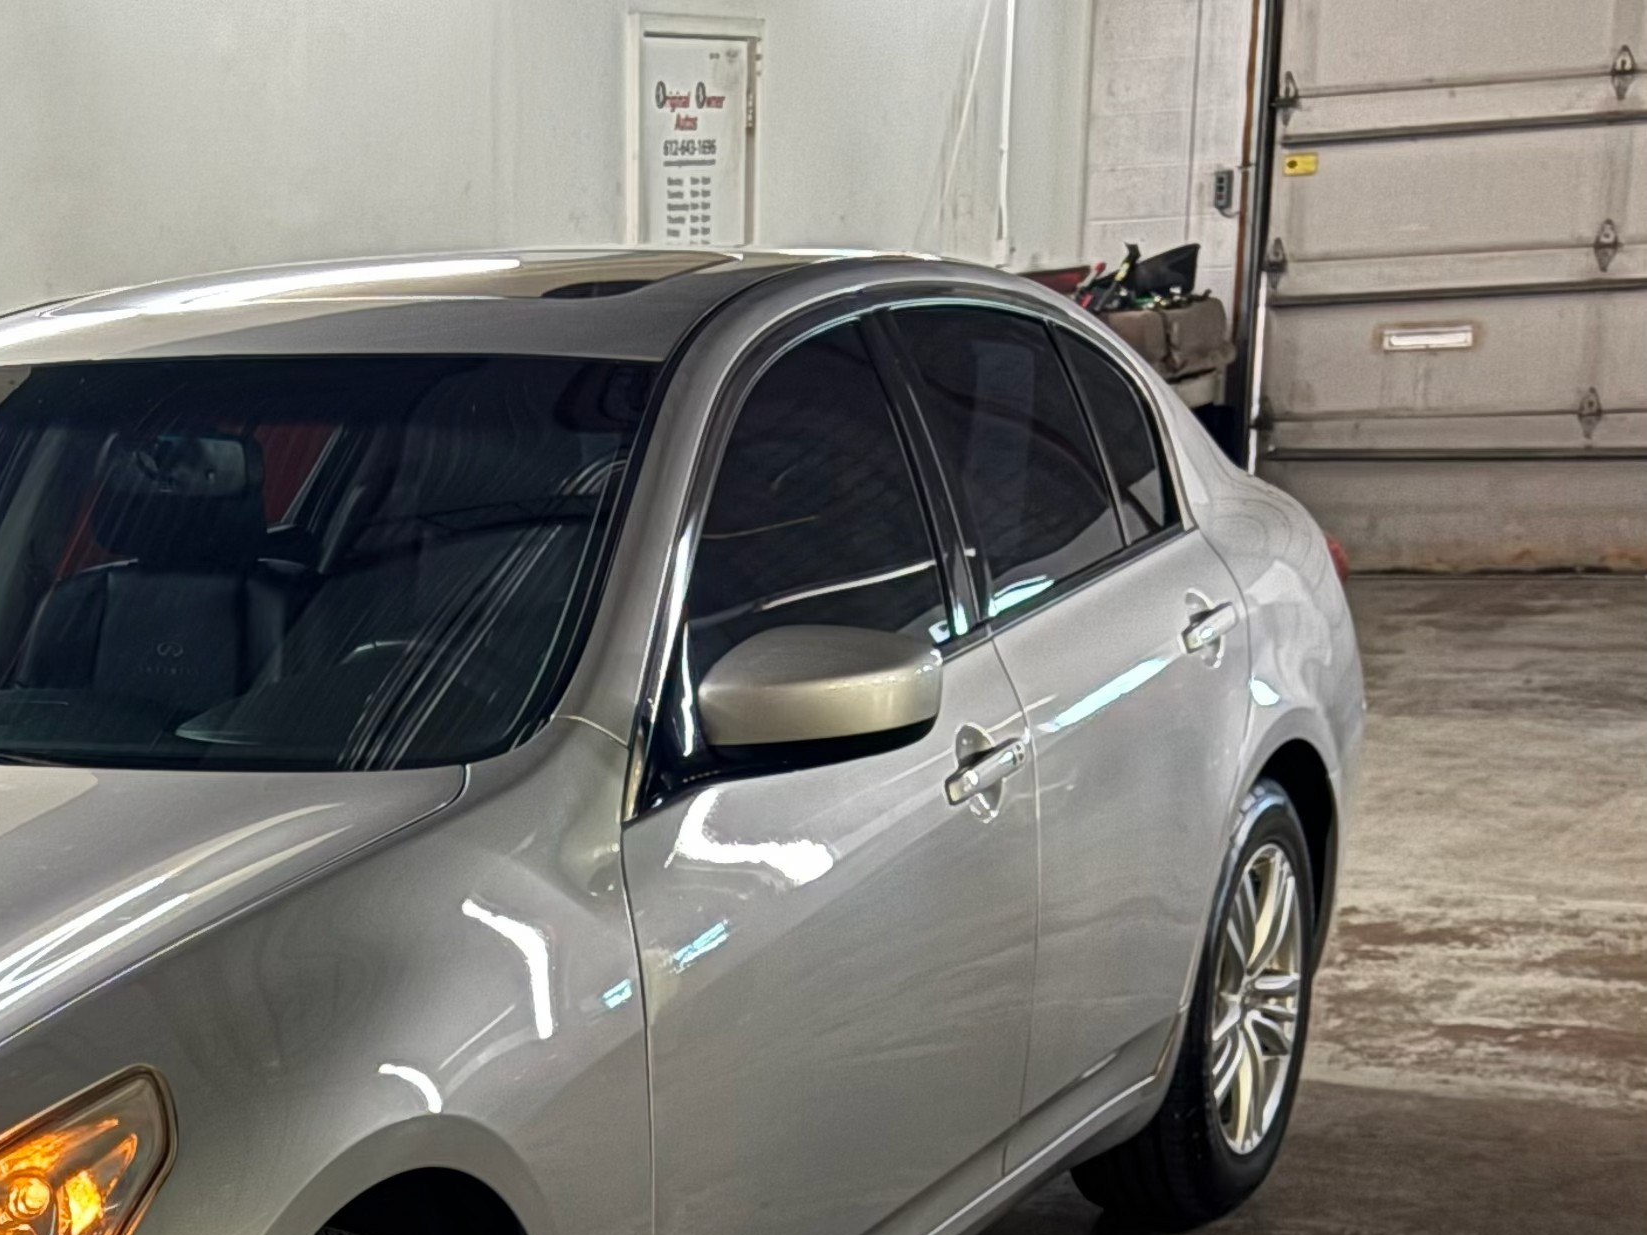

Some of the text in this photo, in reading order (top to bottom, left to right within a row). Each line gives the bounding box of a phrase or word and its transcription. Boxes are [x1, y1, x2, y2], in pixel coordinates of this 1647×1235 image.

[655, 80, 726, 112] Original Owner
[674, 112, 698, 131] Autos
